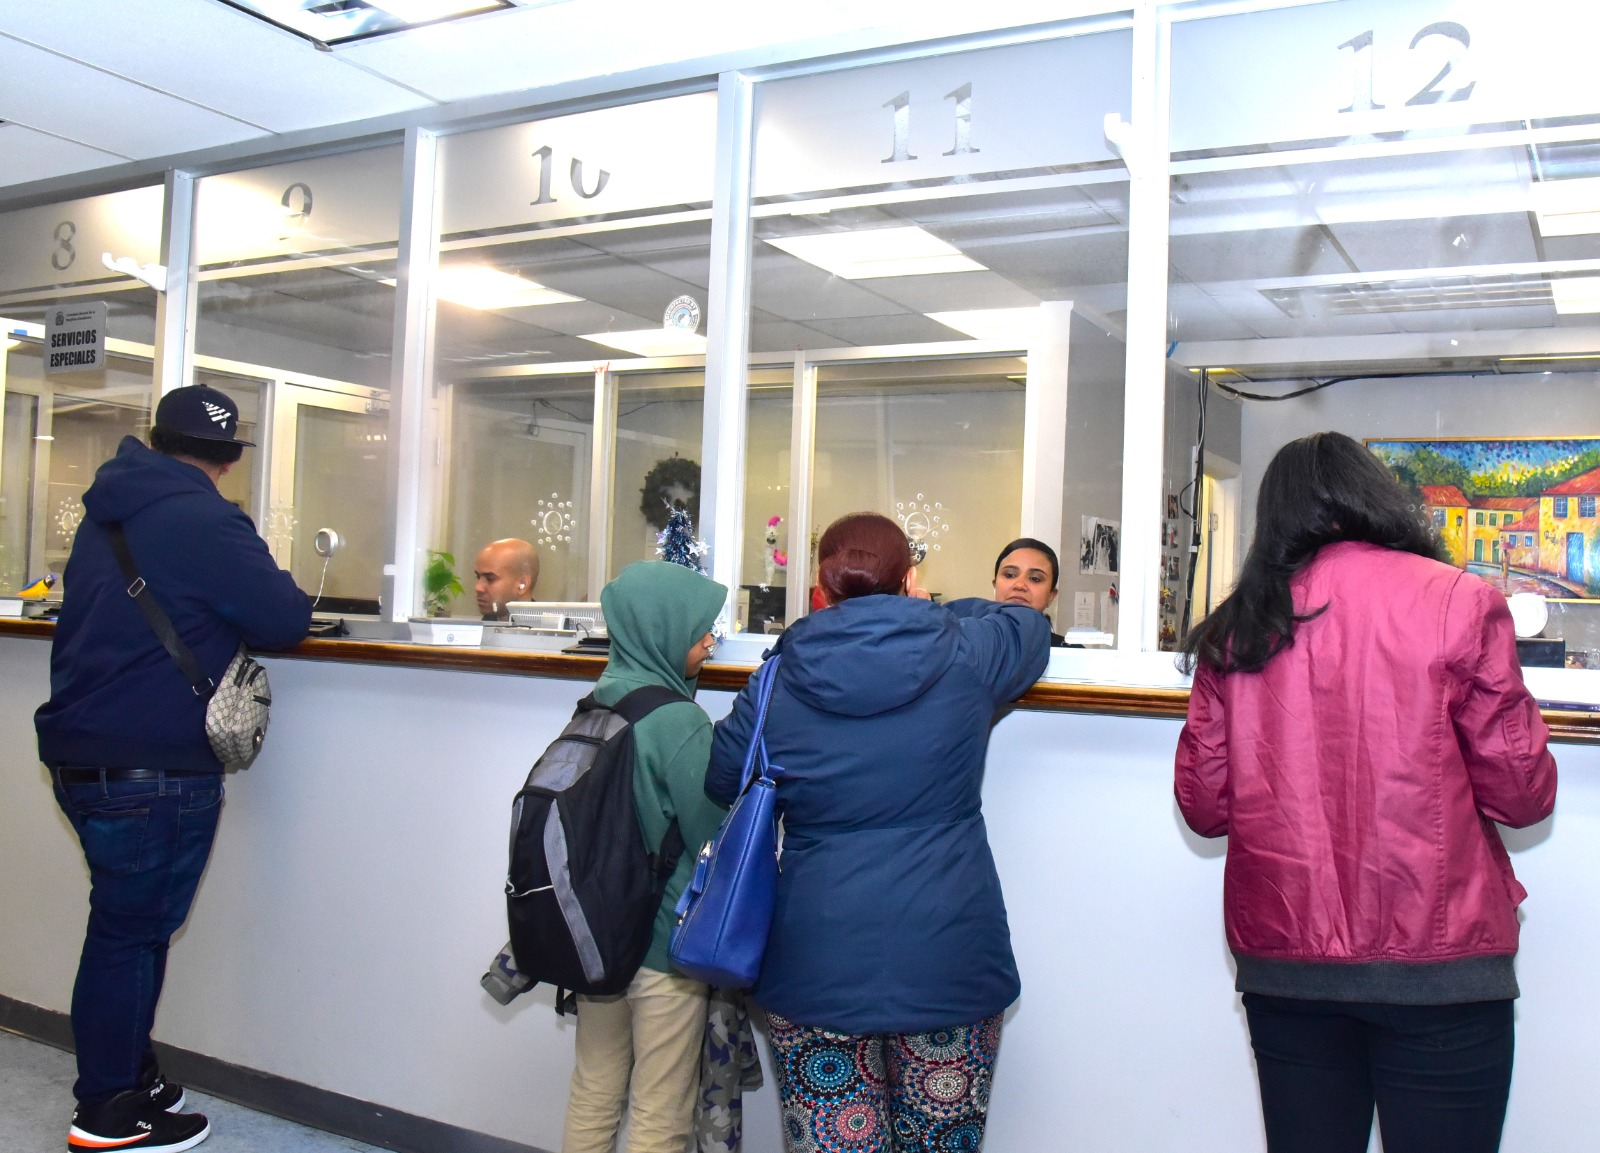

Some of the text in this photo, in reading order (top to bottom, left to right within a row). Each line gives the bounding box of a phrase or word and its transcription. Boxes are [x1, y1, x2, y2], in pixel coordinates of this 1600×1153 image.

[1337, 21, 1477, 113] 12
[881, 81, 981, 163] 11
[530, 145, 610, 205] 10
[51, 221, 76, 270] 8
[51, 329, 97, 348] SERVICIOS
[50, 349, 96, 367] ESPECIALES
[150, 1083, 164, 1097] FILA
[136, 1121, 152, 1130] FILA
